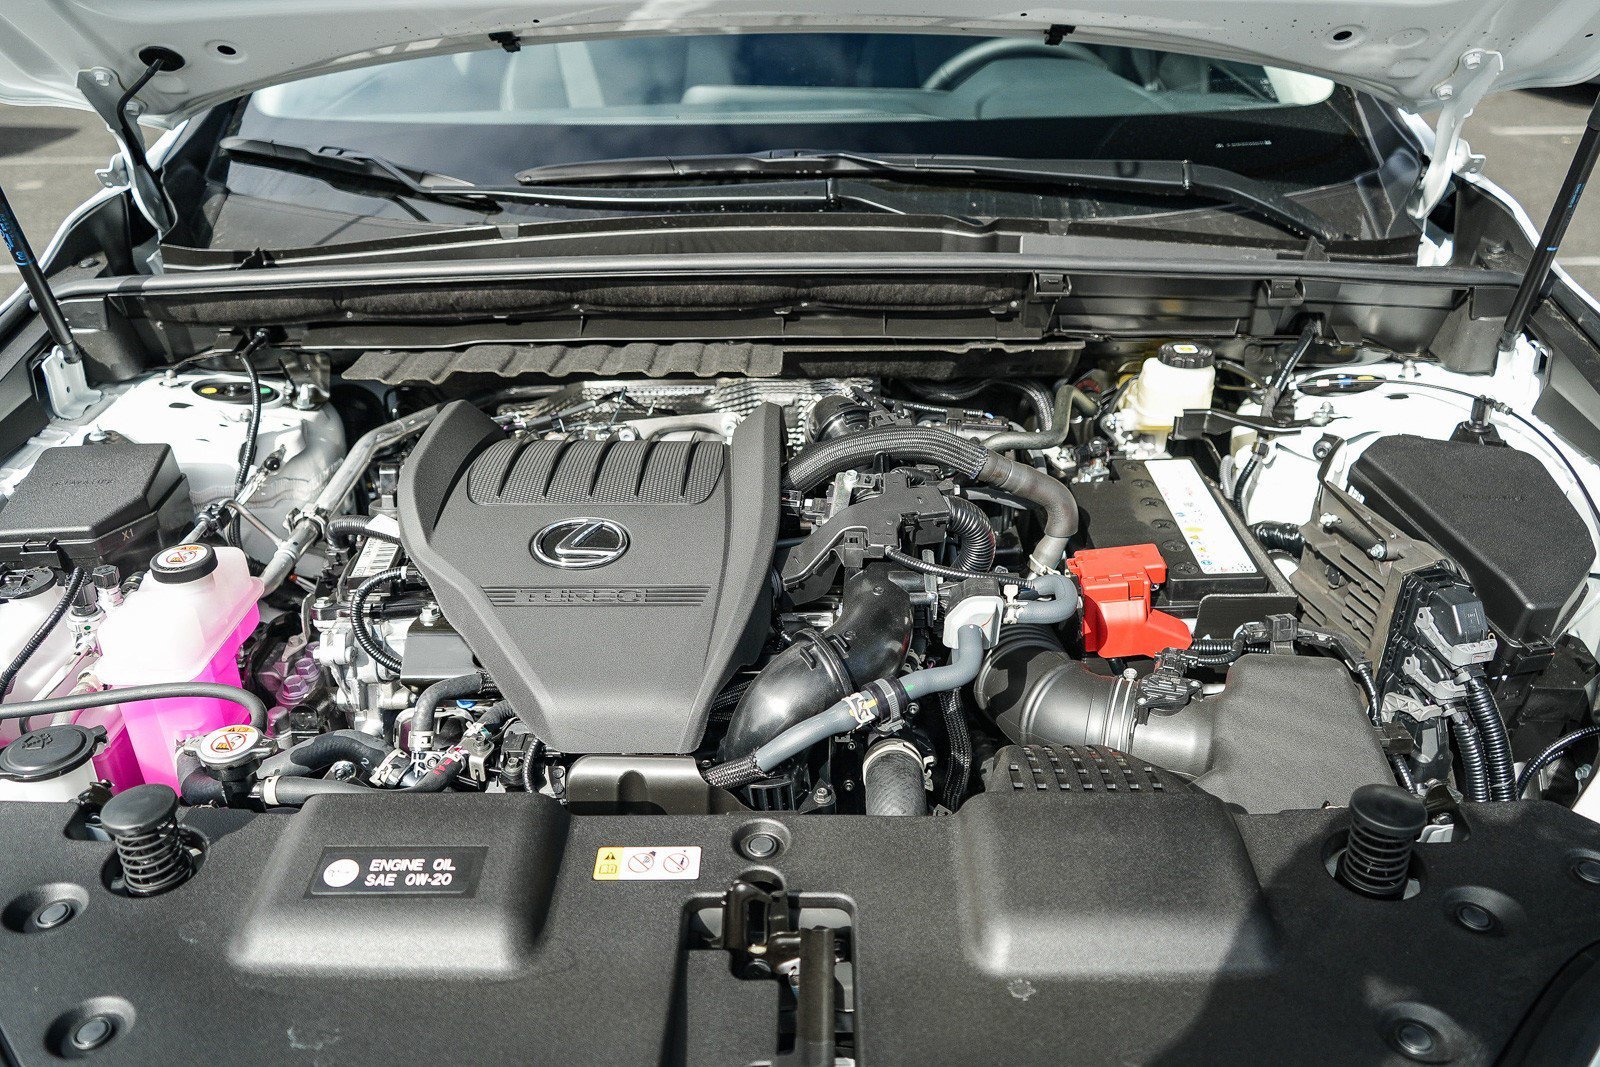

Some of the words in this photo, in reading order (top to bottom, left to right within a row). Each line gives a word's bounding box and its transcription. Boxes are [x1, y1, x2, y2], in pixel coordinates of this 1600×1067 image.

[121, 528, 134, 541] X1
[519, 588, 642, 603] TURBO
[369, 858, 426, 872] ENGINE
[432, 858, 456, 871] OIL
[364, 873, 398, 887] SAE
[404, 873, 453, 886] 0W-20
